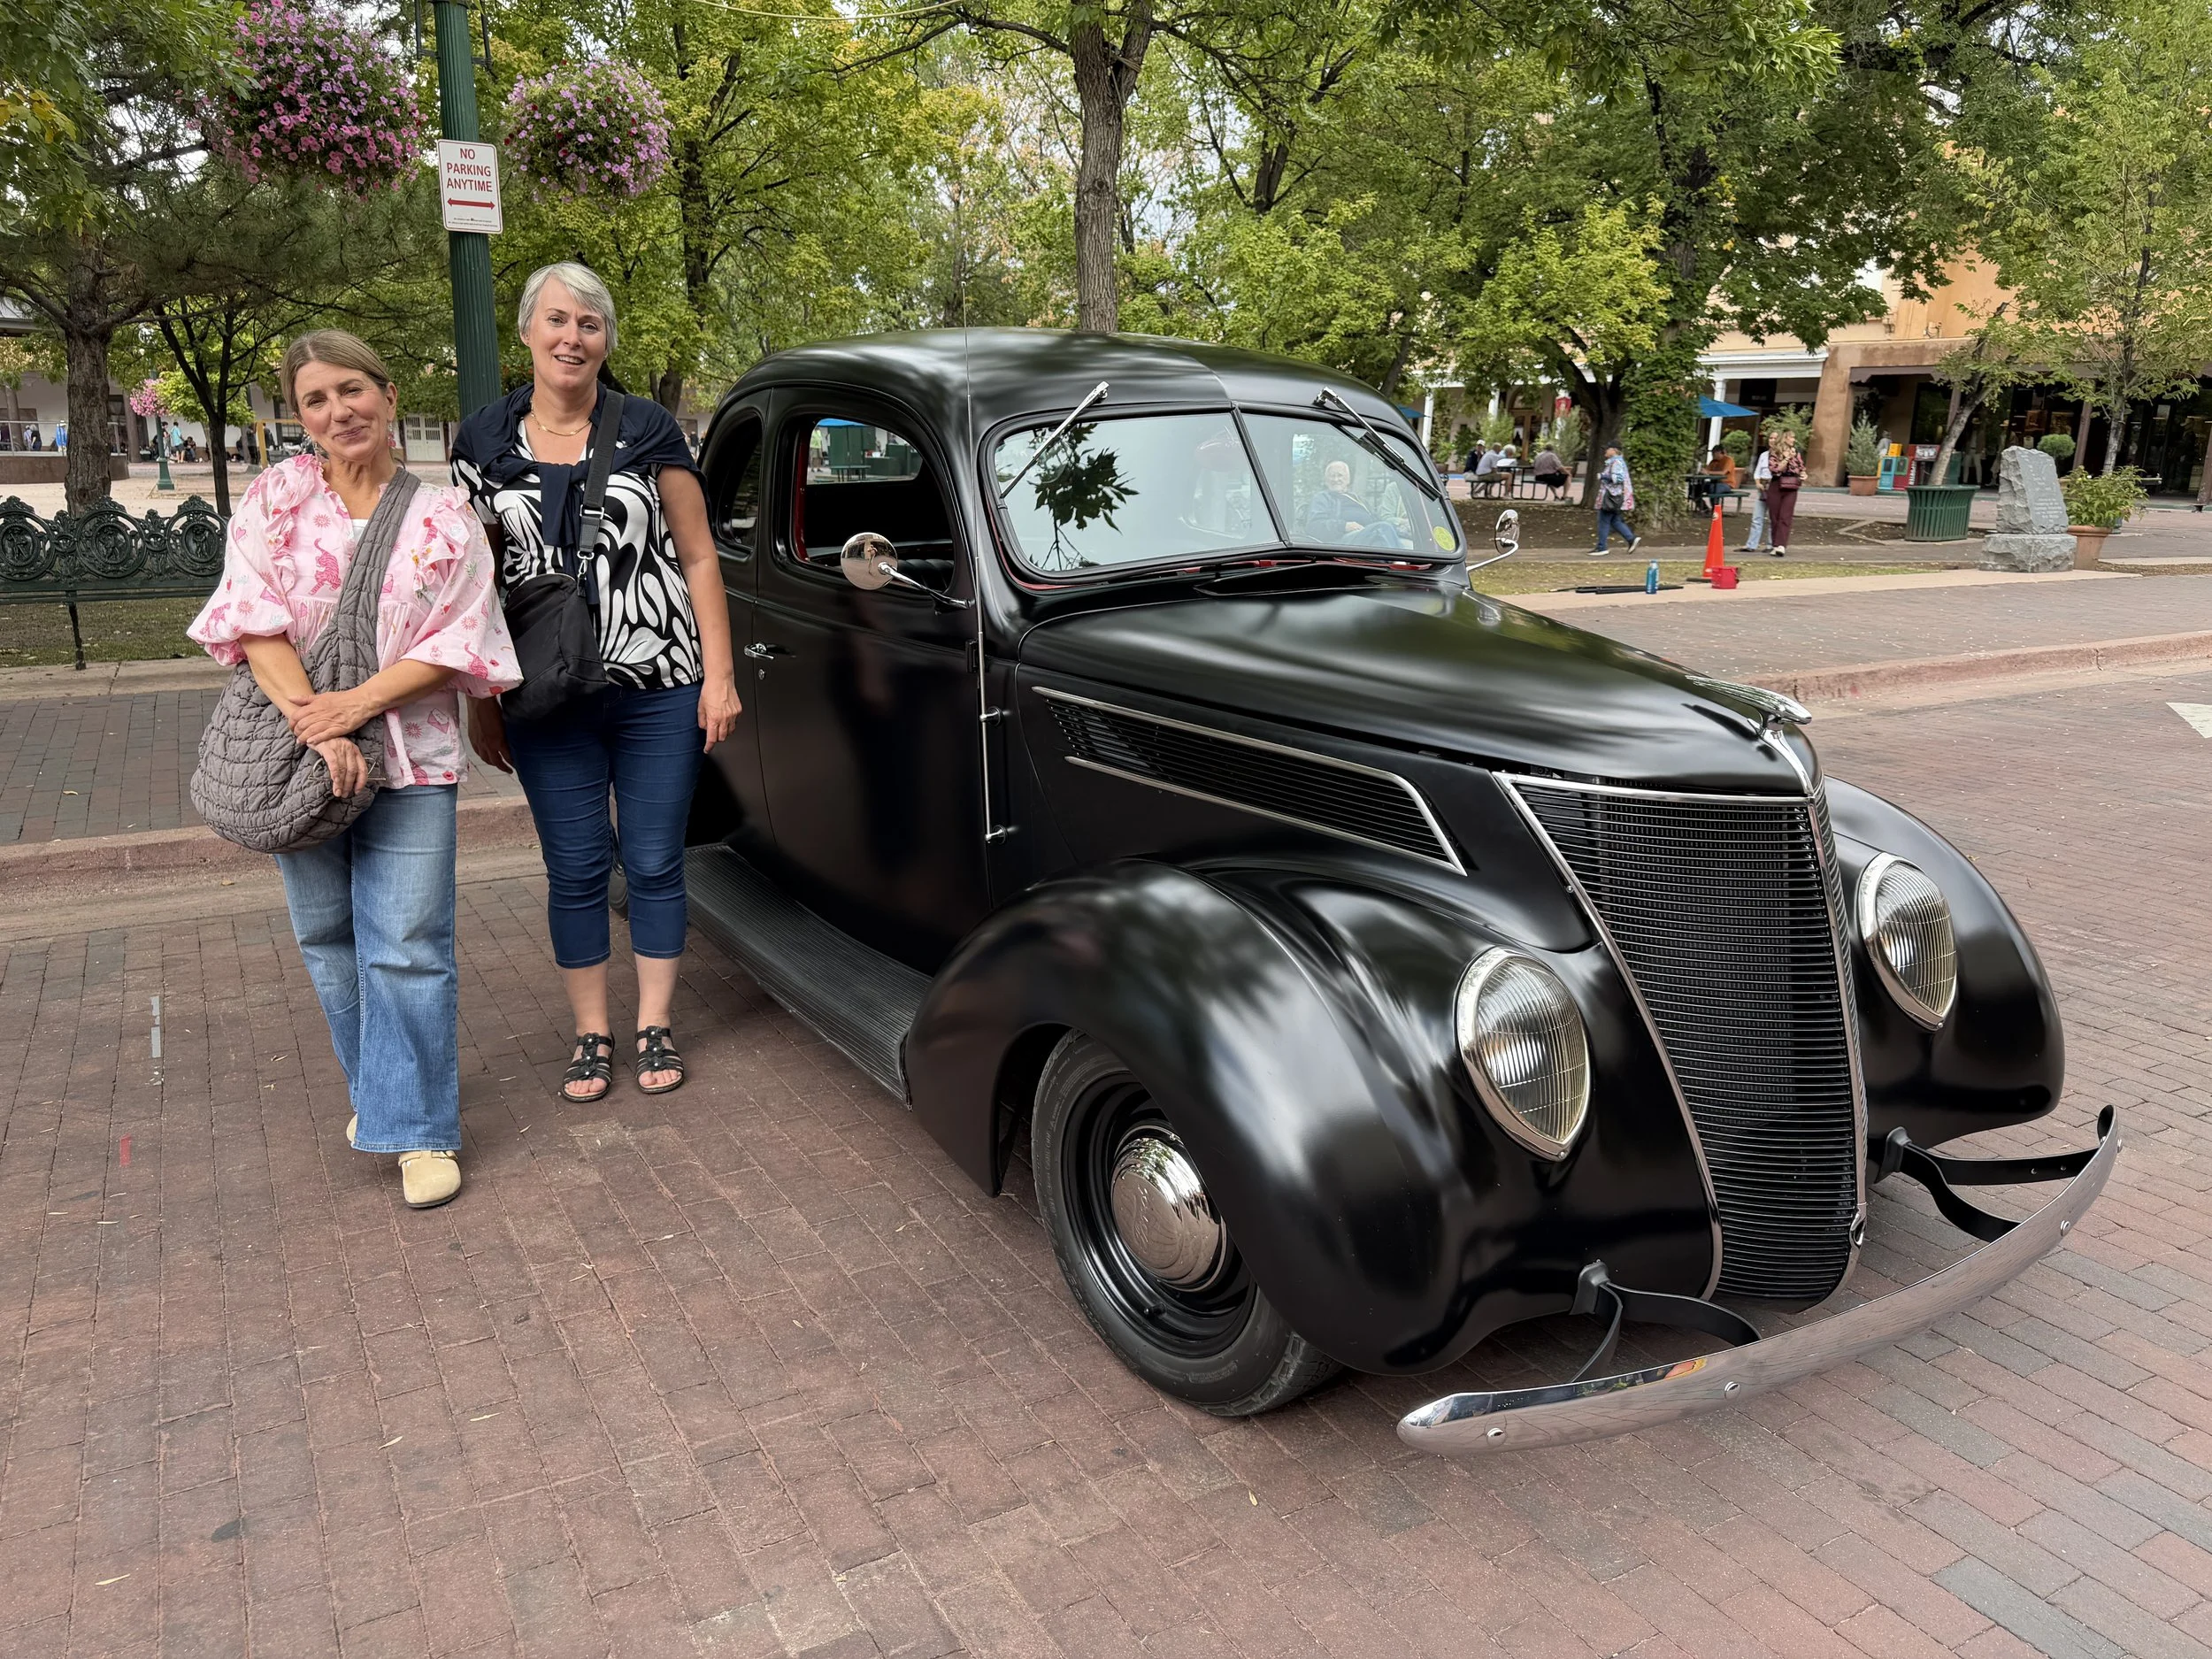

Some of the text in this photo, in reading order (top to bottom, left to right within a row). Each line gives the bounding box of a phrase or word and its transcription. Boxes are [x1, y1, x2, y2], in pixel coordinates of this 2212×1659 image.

[460, 148, 475, 160] NO
[447, 163, 491, 177] PARKING
[447, 178, 493, 192] ANYTIME
